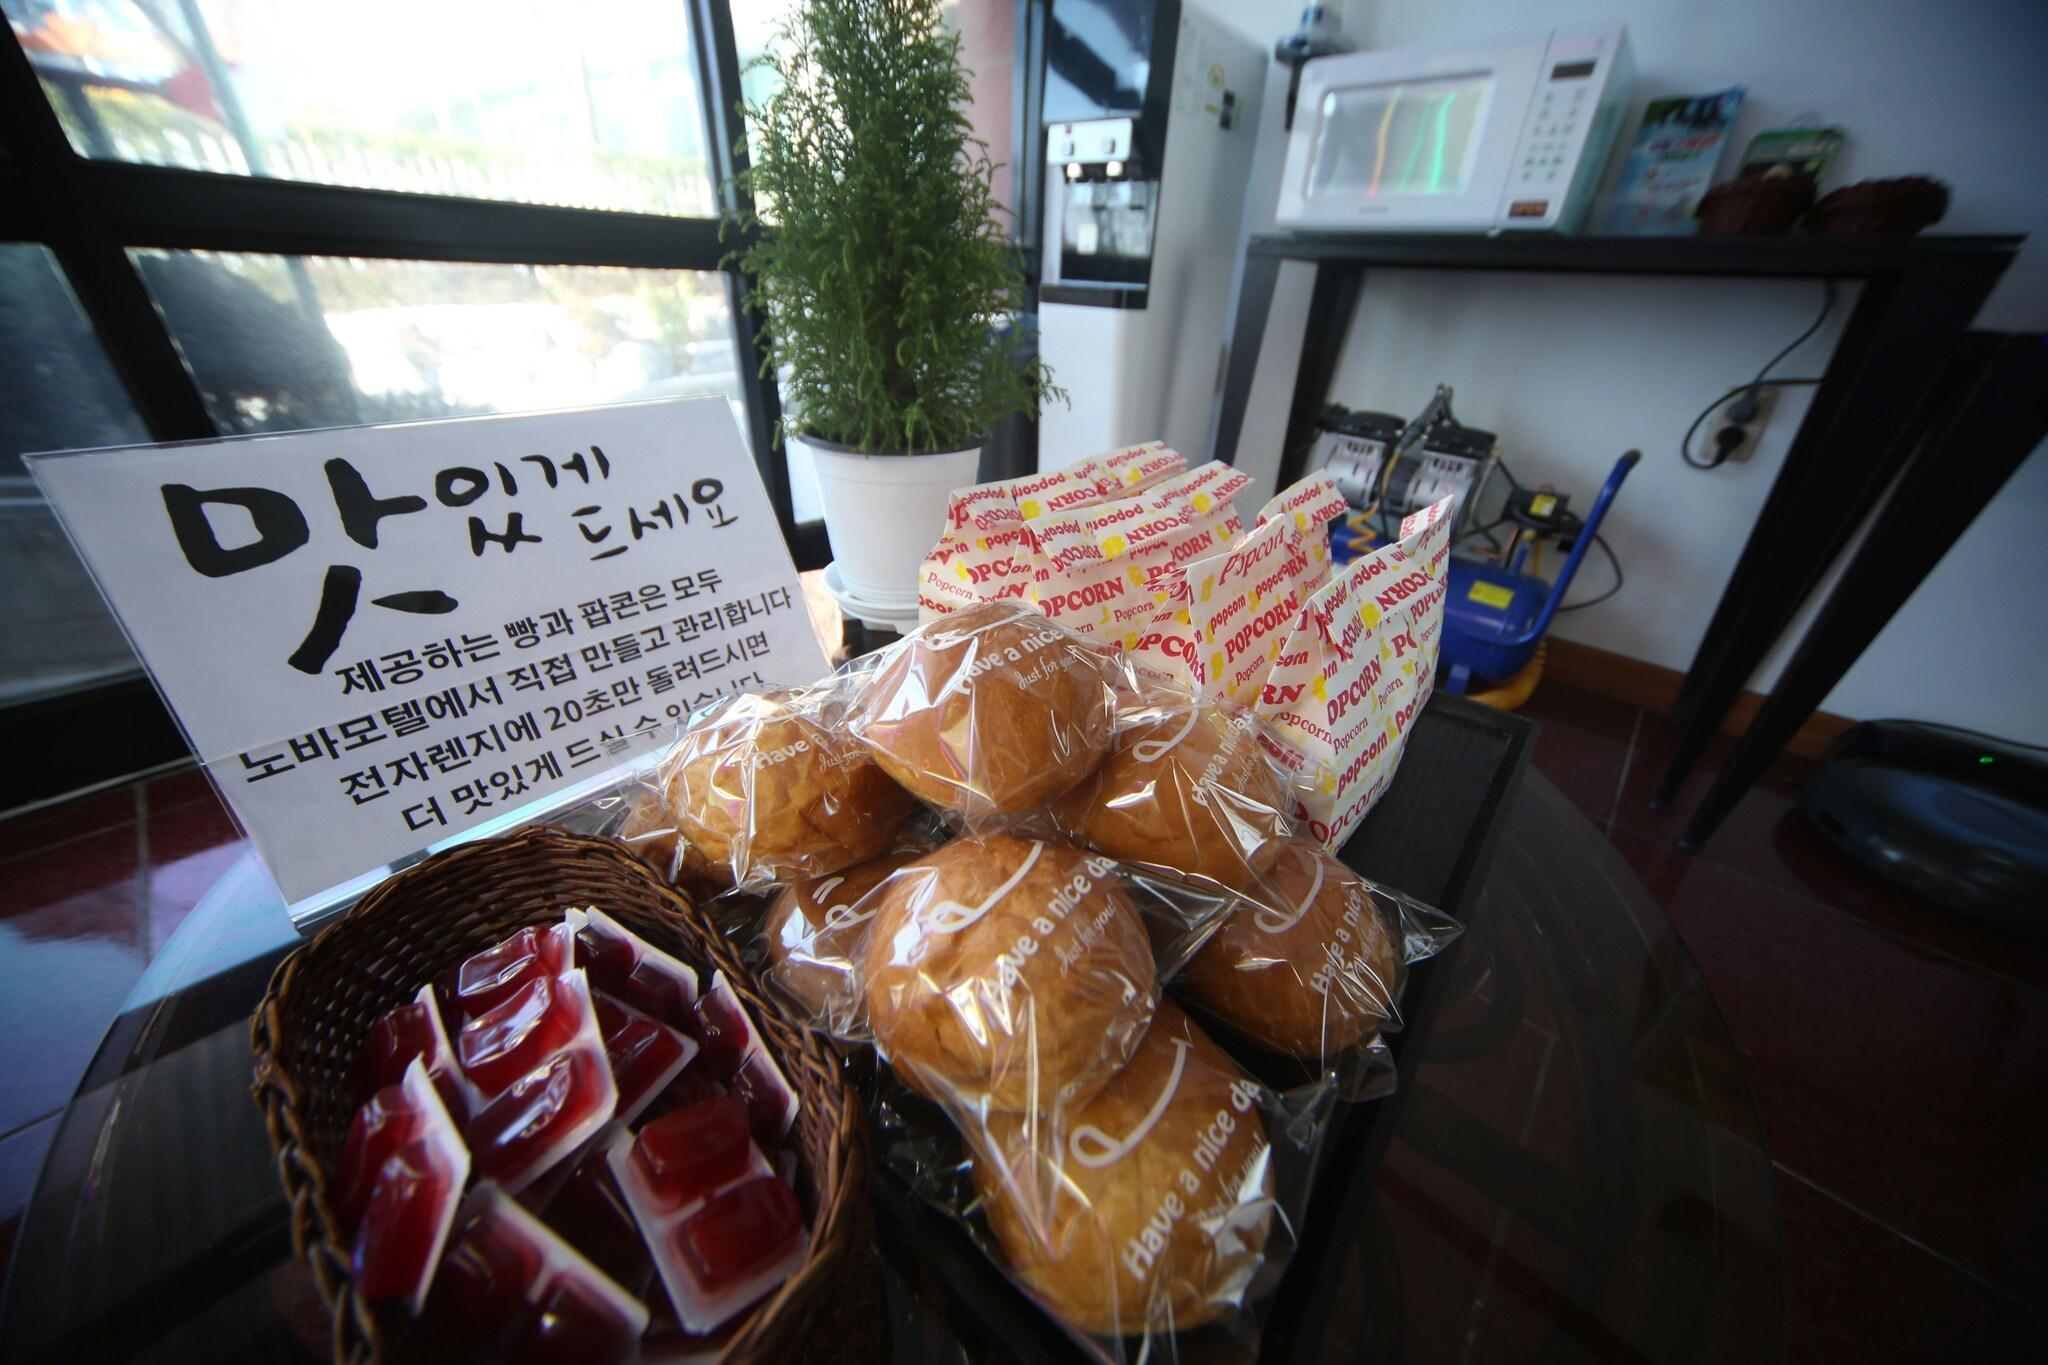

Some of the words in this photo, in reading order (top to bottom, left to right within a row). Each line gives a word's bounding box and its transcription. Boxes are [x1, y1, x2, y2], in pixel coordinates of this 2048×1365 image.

[161, 445, 610, 675] 맛있게
[571, 478, 738, 561] 드세요
[927, 571, 974, 600] Popcorn
[335, 633, 501, 696] 제공하는
[503, 607, 574, 649] 빵과
[577, 583, 668, 630] 팝콘은
[671, 568, 723, 601] 모두
[1114, 600, 1154, 623] Popcorn
[1225, 590, 1300, 664] POPCORN
[1003, 647, 1022, 661] a
[1020, 630, 1065, 653] nice
[1235, 654, 1265, 687] Popcorn
[238, 675, 504, 784] 노바모텔에서
[506, 652, 578, 692] 직접
[580, 625, 671, 673] 만들고
[672, 586, 792, 643] 관리합니다
[1014, 667, 1042, 690] Just
[339, 711, 542, 806] 전자렌지에
[543, 676, 643, 731] 20초만
[646, 630, 771, 696] 돌려드시면
[1333, 717, 1369, 756] Popcorn
[401, 796, 448, 832] 더
[450, 750, 564, 815] 맛있게
[565, 724, 631, 769] 드실
[1032, 915, 1056, 936] a
[1047, 874, 1092, 919] nice
[1335, 927, 1352, 943] a
[1121, 1191, 1186, 1282] Have
[1178, 1168, 1200, 1196] a
[1192, 1109, 1236, 1172] nice
